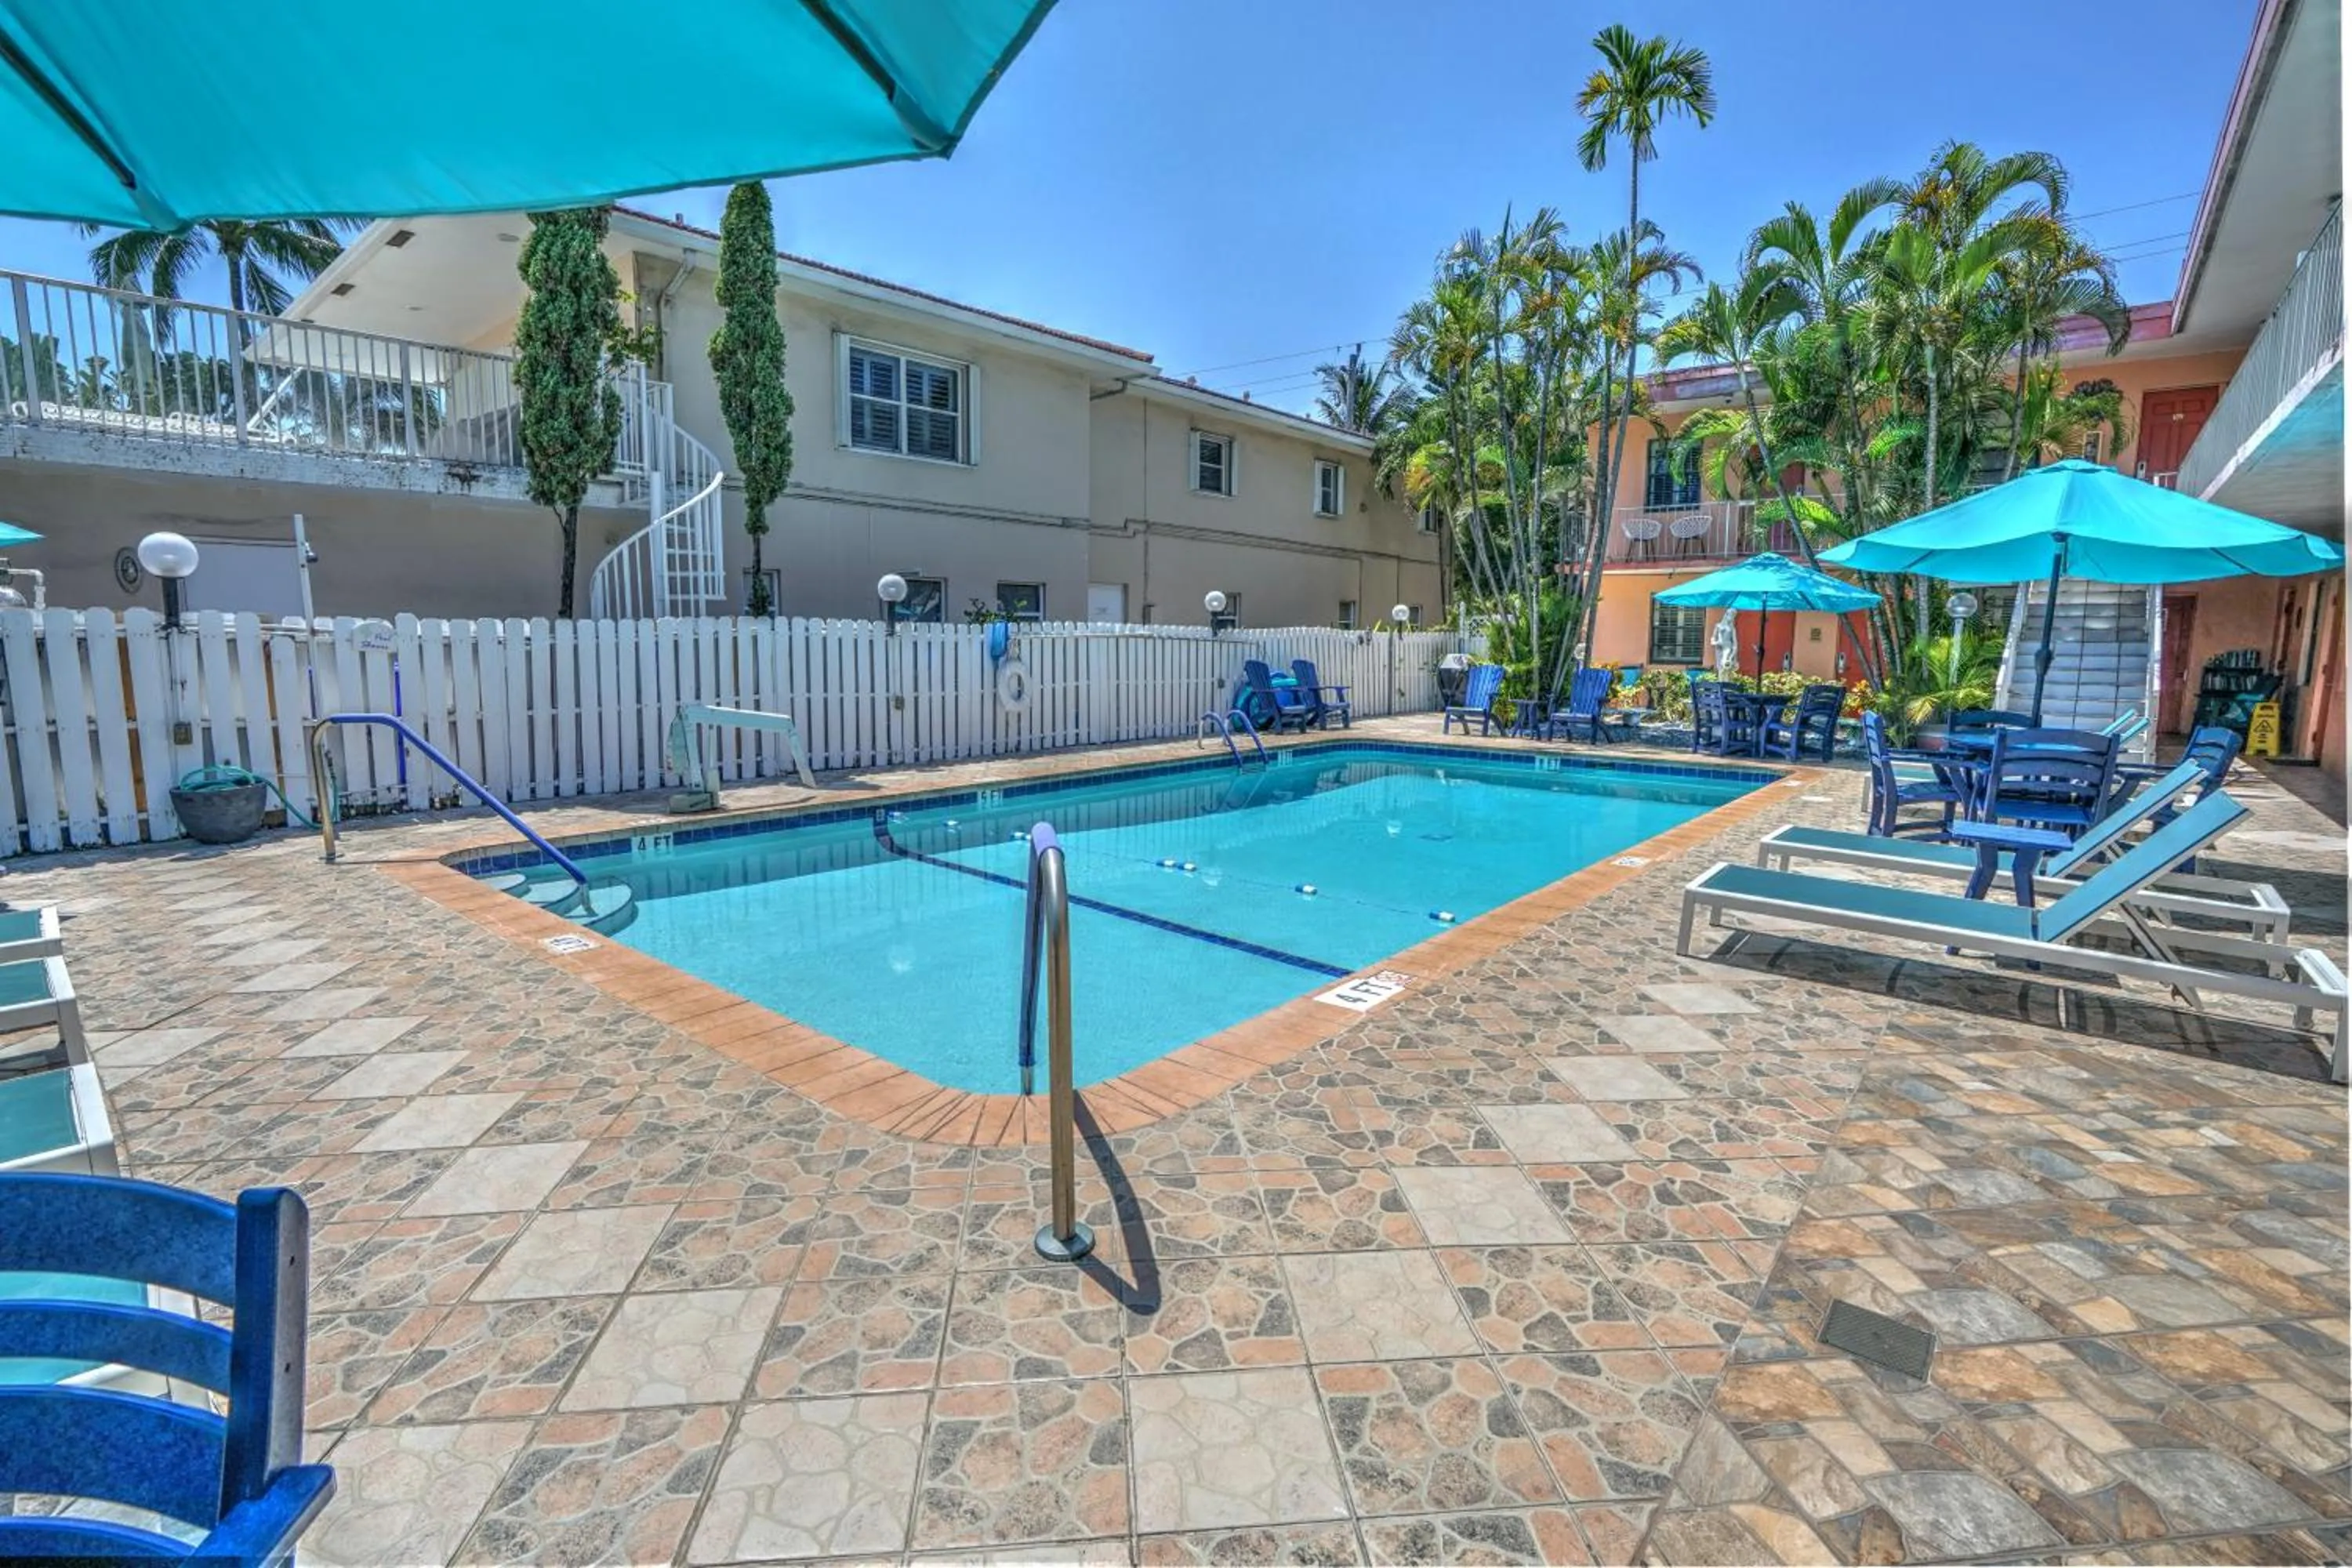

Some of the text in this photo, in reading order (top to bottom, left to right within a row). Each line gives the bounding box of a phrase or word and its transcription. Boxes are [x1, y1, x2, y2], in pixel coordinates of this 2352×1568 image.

[654, 834, 672, 851] FT
[1335, 981, 1393, 1004] 4 FT
